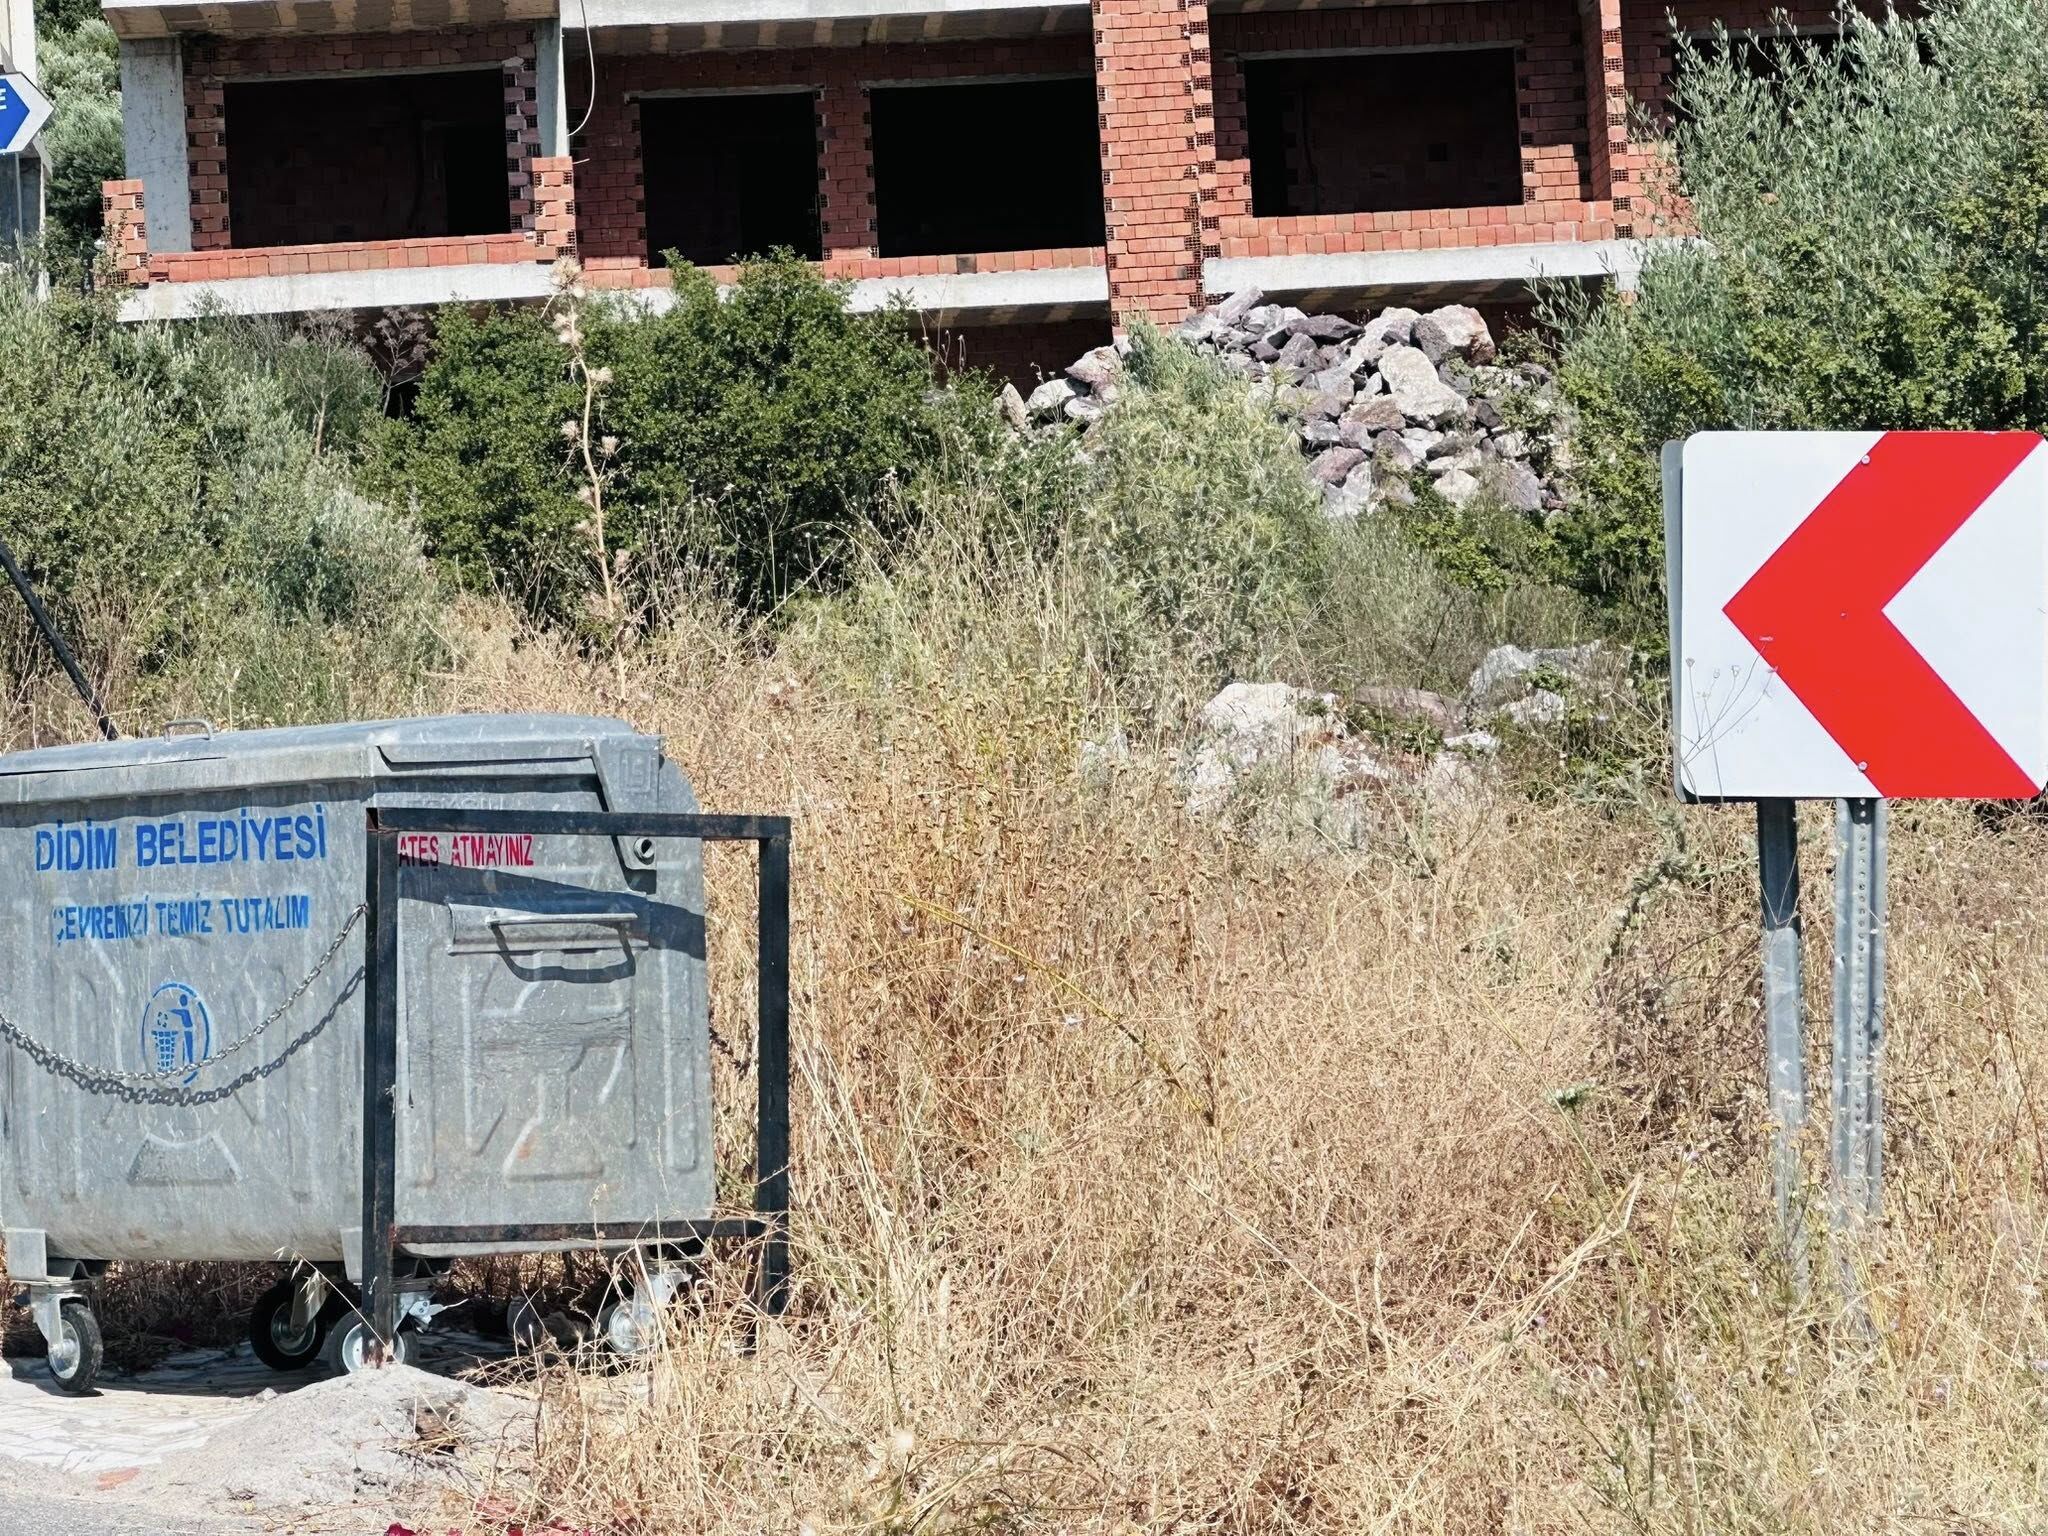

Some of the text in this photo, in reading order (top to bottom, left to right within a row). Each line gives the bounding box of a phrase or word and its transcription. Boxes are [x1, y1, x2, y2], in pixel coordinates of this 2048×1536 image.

[36, 804, 326, 871] DİDİM BELEDİYESİ
[399, 834, 534, 871] ATEŞ ATMAYINIZ
[220, 895, 310, 934] TUTALIM
